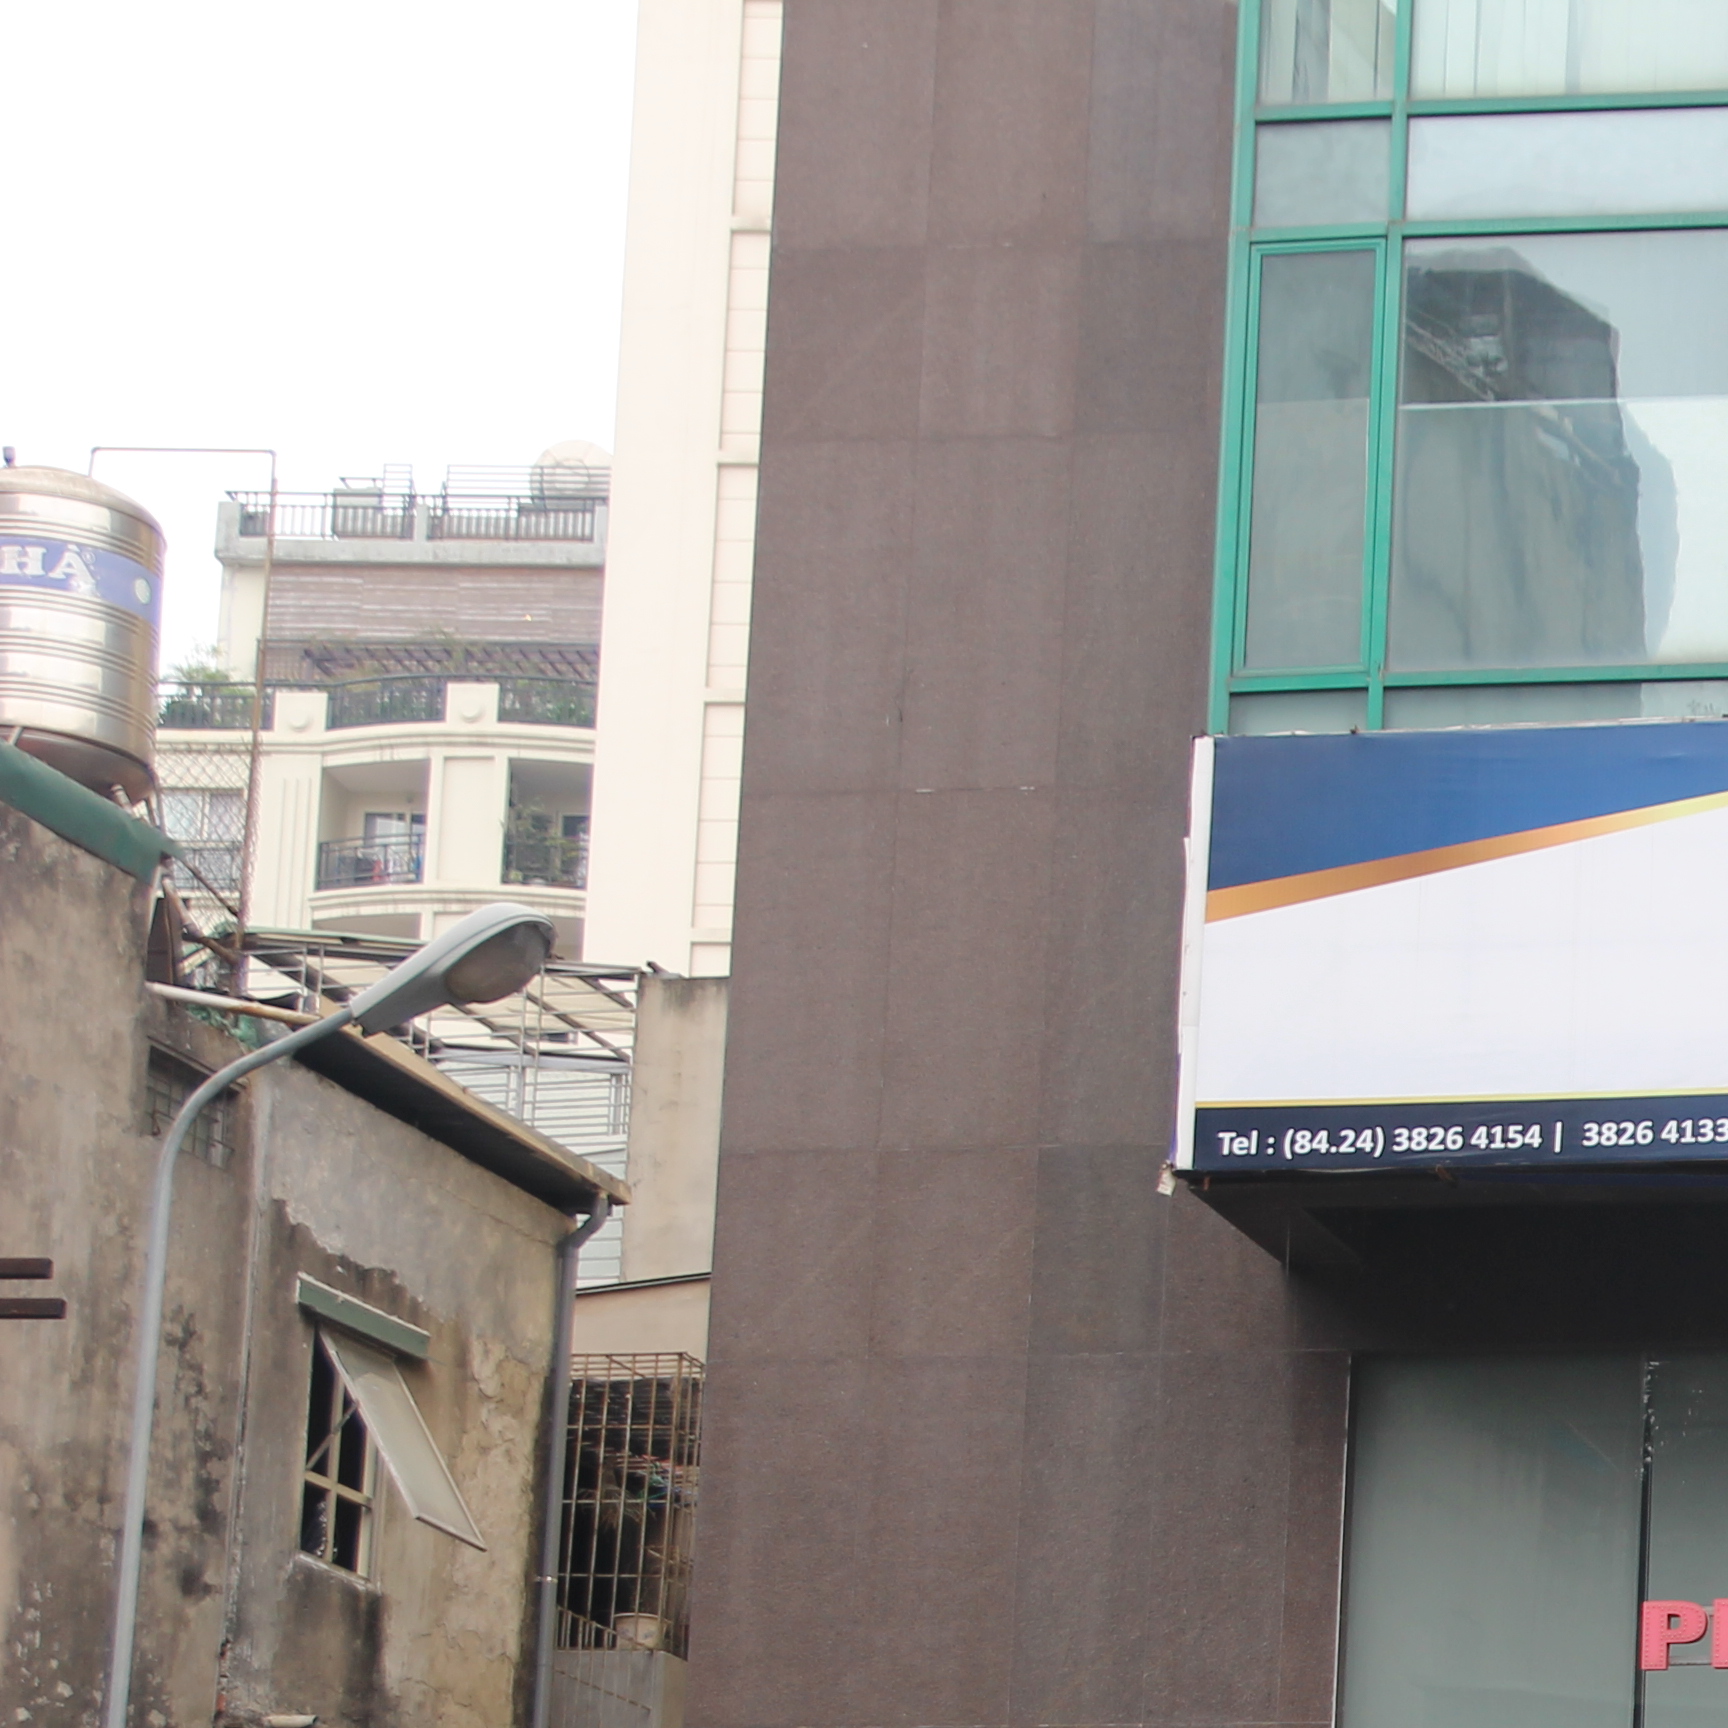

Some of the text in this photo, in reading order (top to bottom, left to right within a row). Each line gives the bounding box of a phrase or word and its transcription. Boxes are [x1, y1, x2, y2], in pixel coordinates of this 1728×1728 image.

[1217, 1130, 1258, 1156] Tel
[1283, 1126, 1384, 1160] (84.24)
[1392, 1126, 1463, 1152] 3826
[1470, 1124, 1542, 1149] 4154
[1582, 1120, 1654, 1146] 3826
